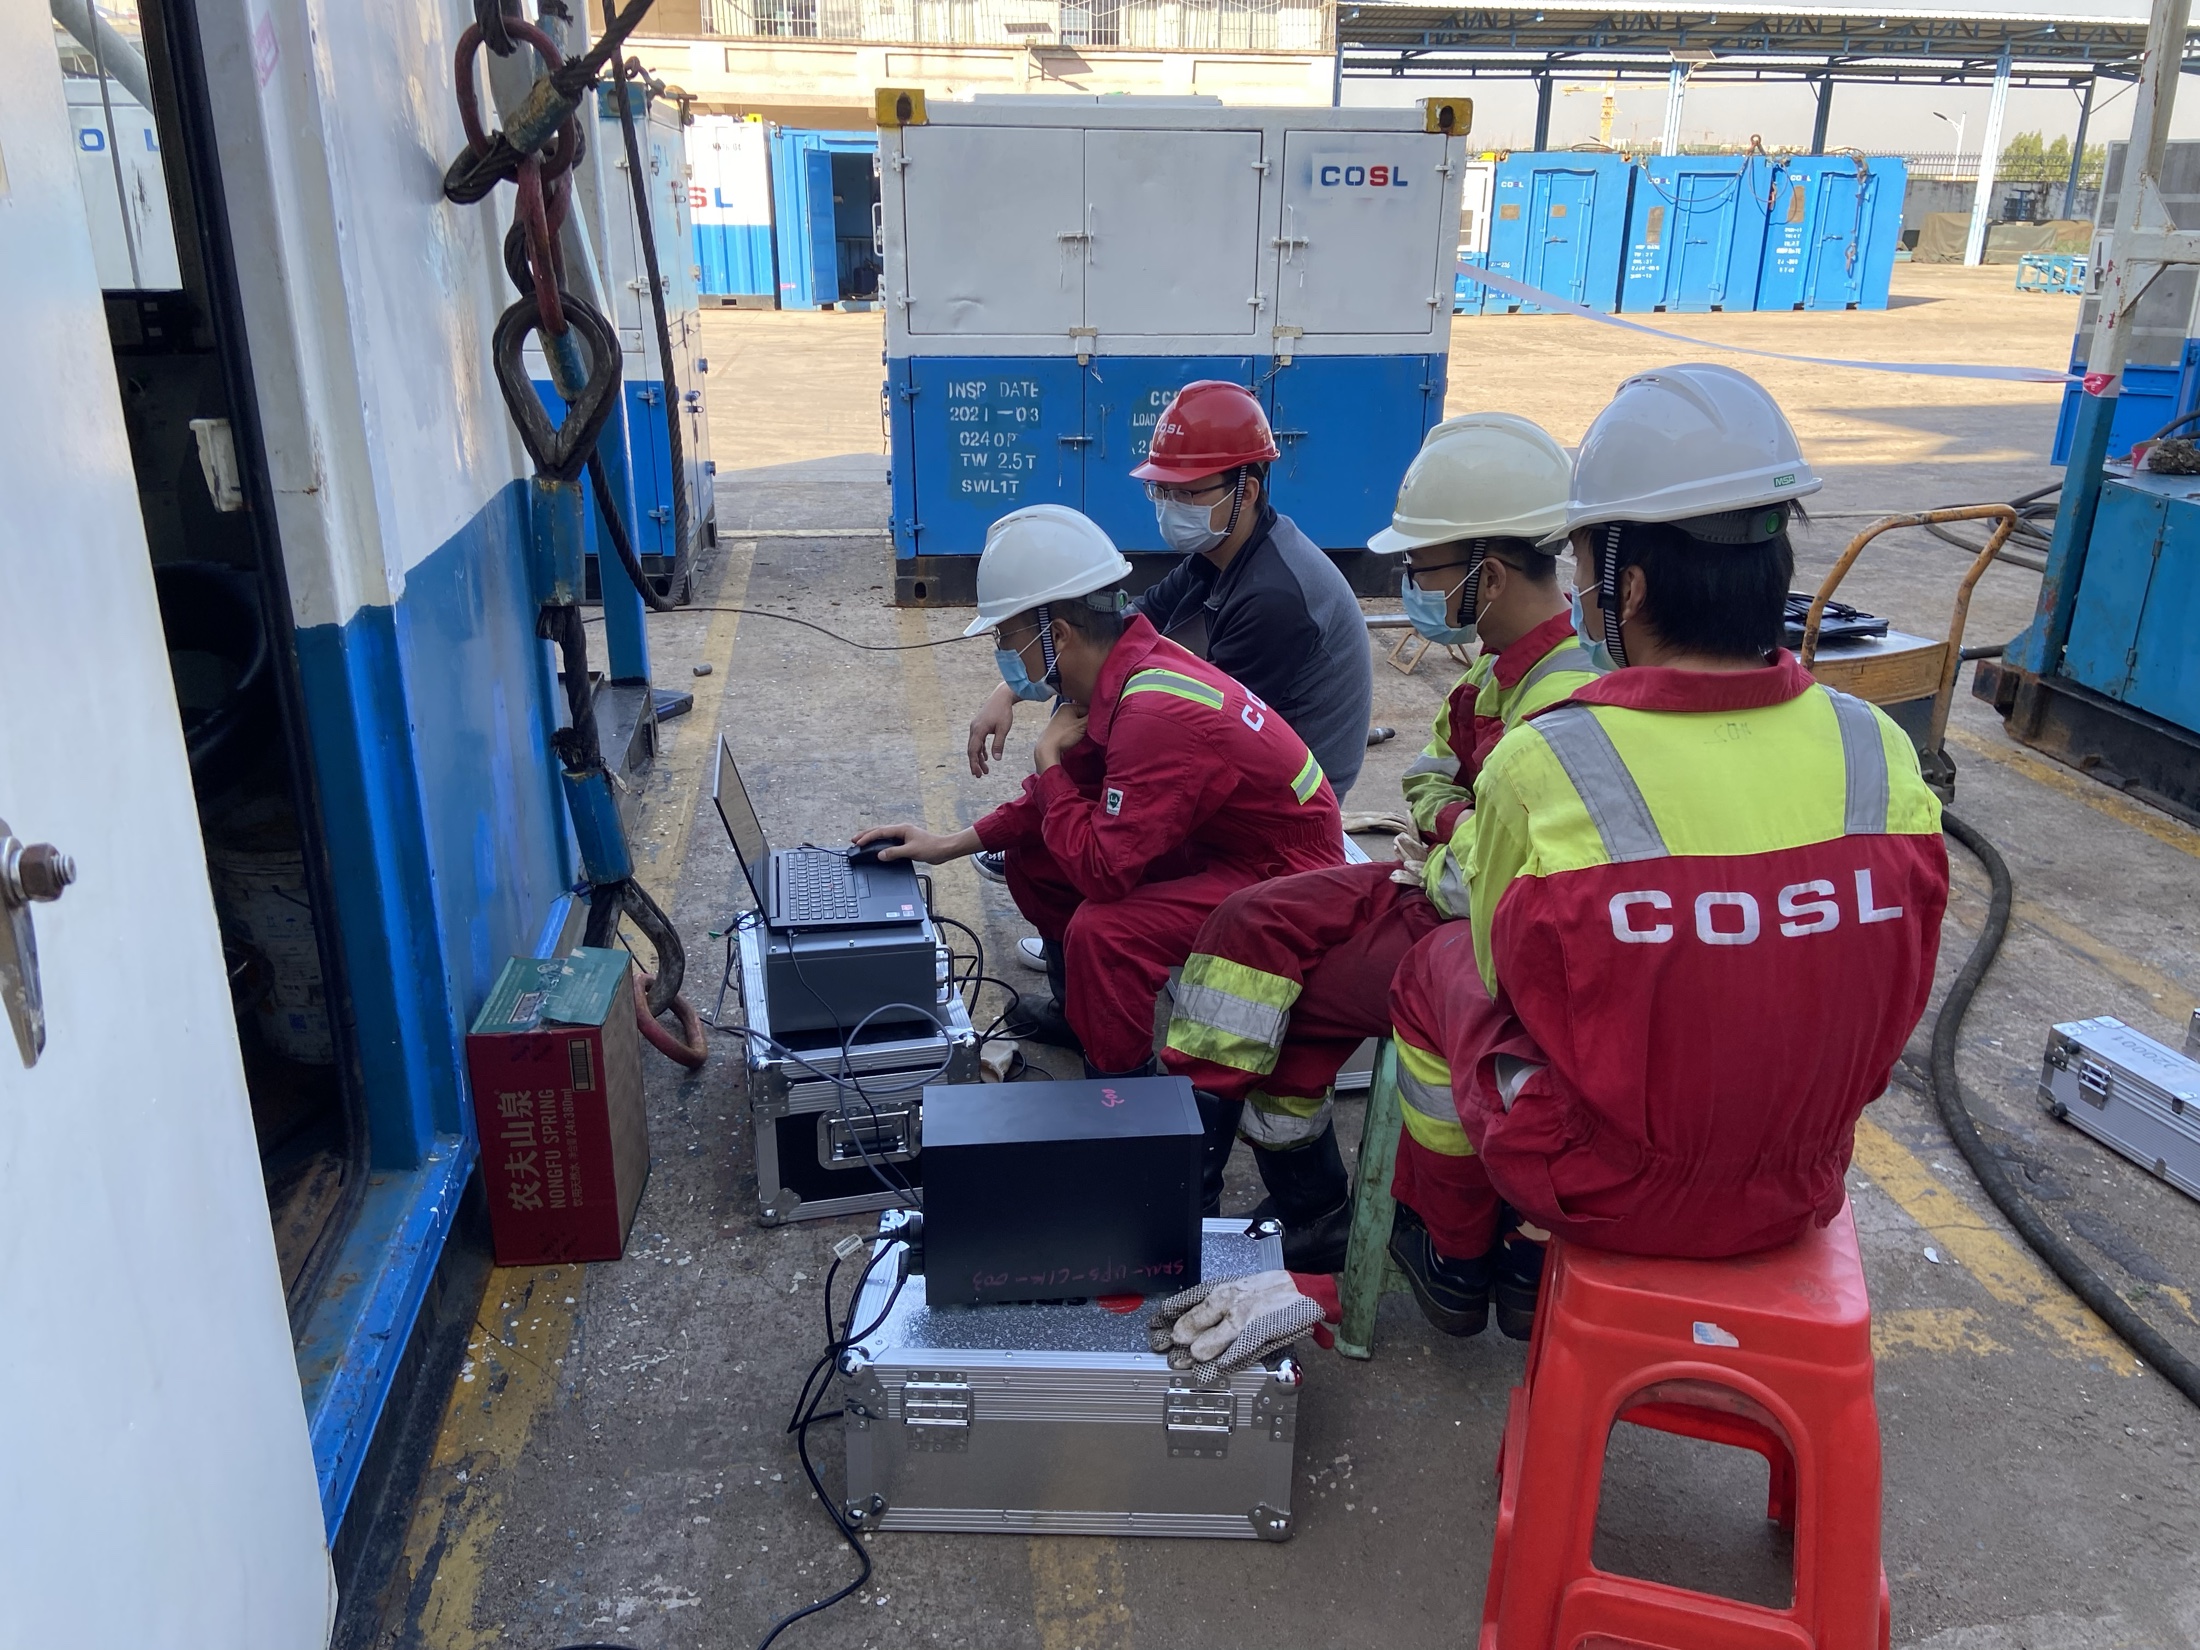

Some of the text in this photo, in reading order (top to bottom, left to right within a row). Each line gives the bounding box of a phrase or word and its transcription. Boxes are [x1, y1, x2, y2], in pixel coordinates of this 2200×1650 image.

[1321, 165, 1408, 187] COSL
[949, 381, 1039, 399] INSP DATE
[1133, 413, 1156, 427] LOAD
[1156, 422, 1184, 436] OSL
[960, 453, 987, 467] TW
[961, 479, 1019, 494] SWL1T
[1775, 475, 1795, 487] MSA
[1608, 867, 1903, 945] COSL
[498, 1089, 544, 1212] 农夫山泉
[538, 1088, 566, 1210] NONGFU SPRING
[569, 1161, 584, 1208] 饮用天然水
